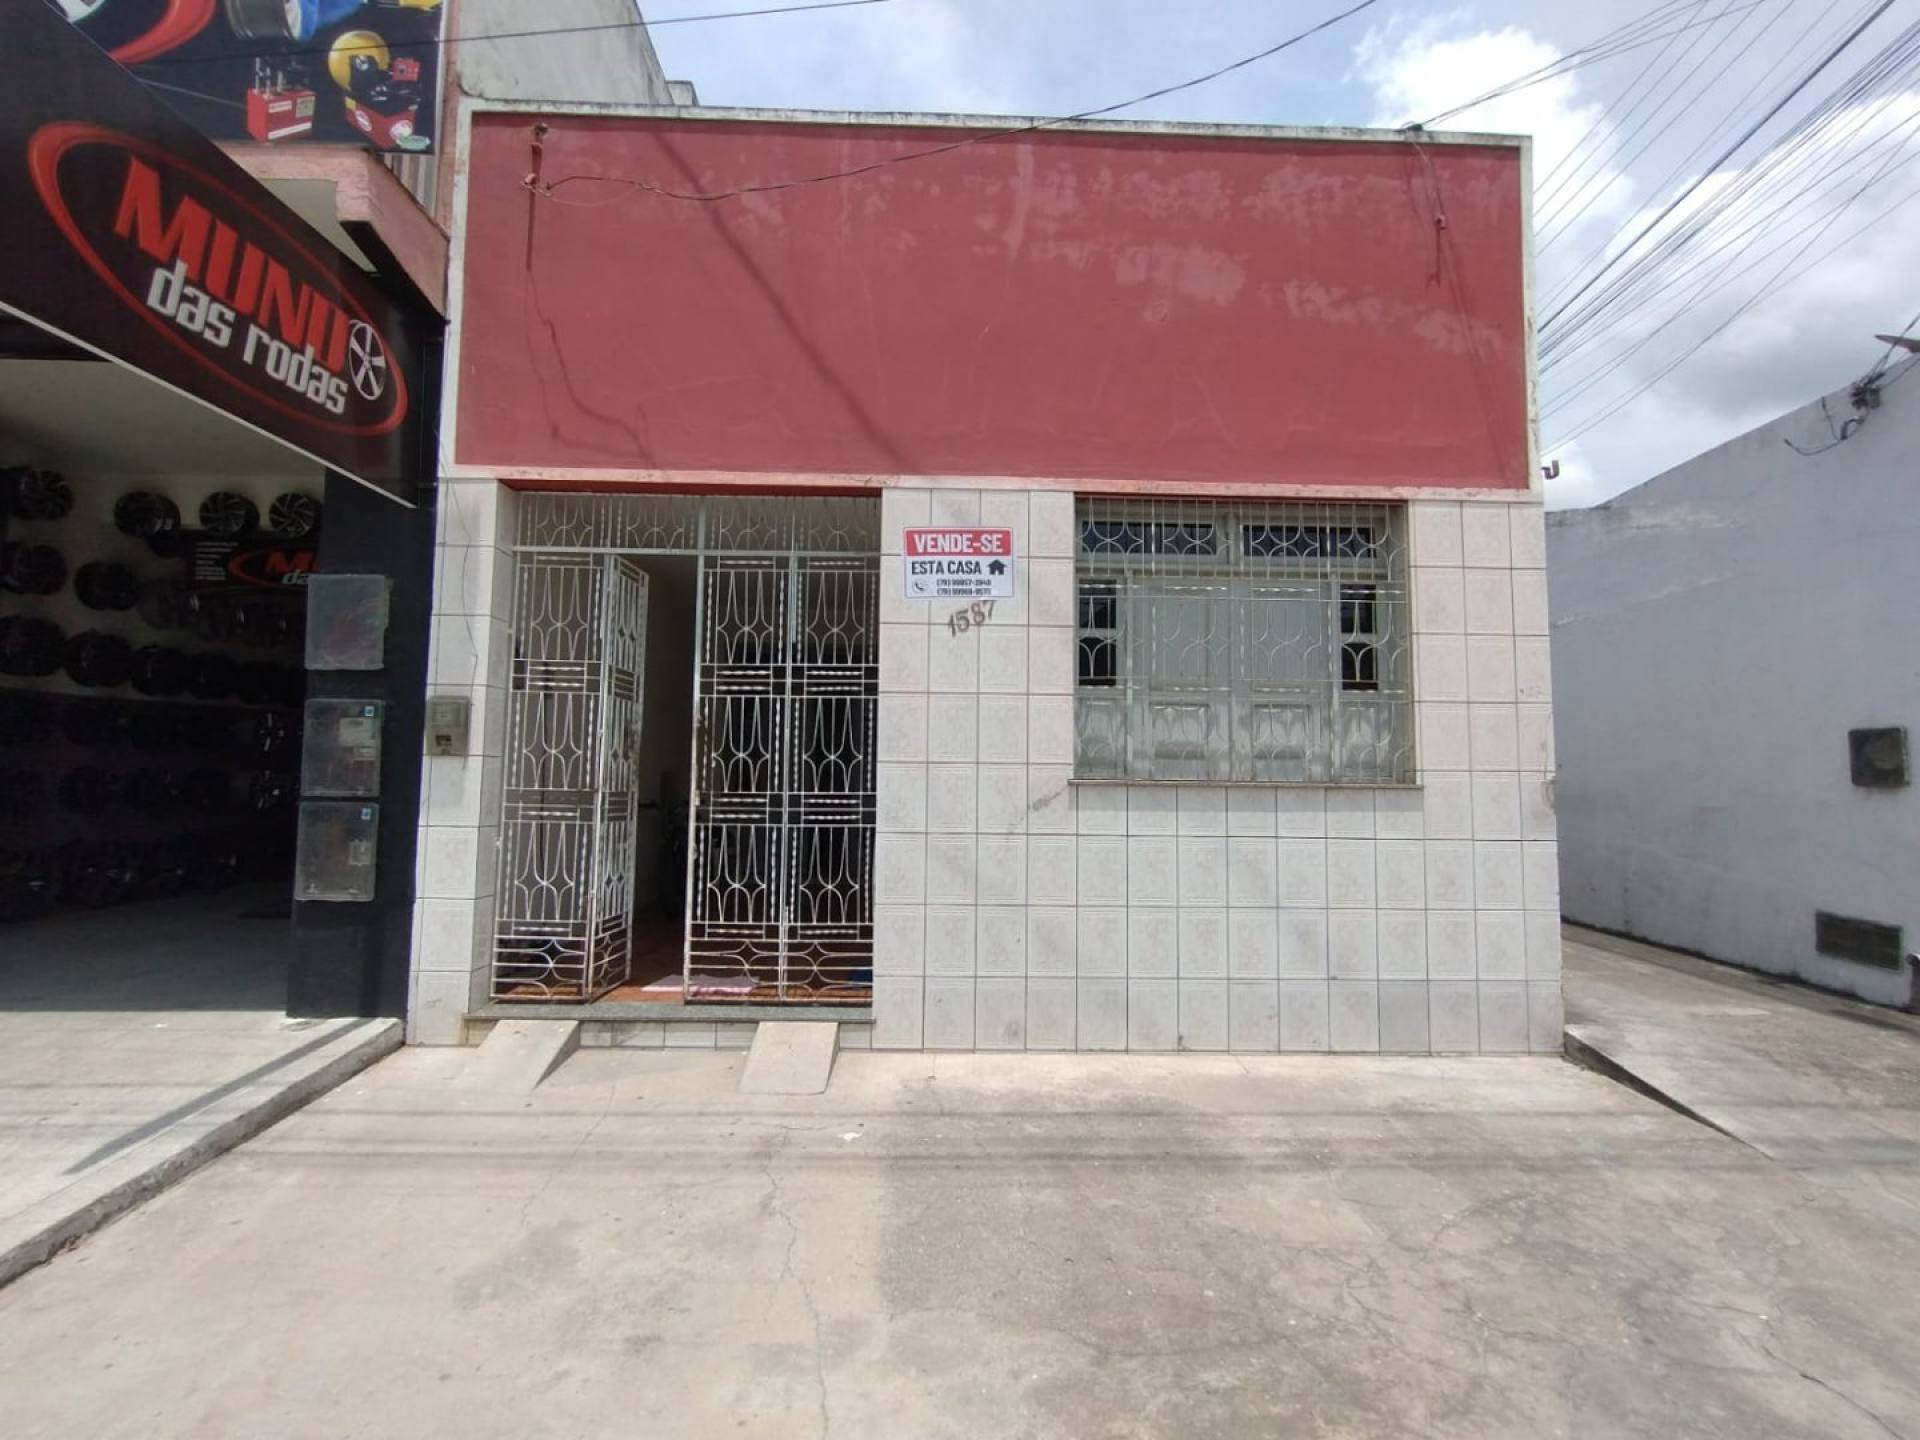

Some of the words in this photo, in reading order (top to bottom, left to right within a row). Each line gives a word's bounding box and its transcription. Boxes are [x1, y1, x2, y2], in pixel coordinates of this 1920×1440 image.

[146, 258, 236, 348] das
[243, 321, 349, 415] rodas
[913, 533, 1004, 553] VENDE-SE
[911, 561, 945, 575] ESTA
[947, 561, 982, 575] CASA
[948, 600, 998, 638] 1587
